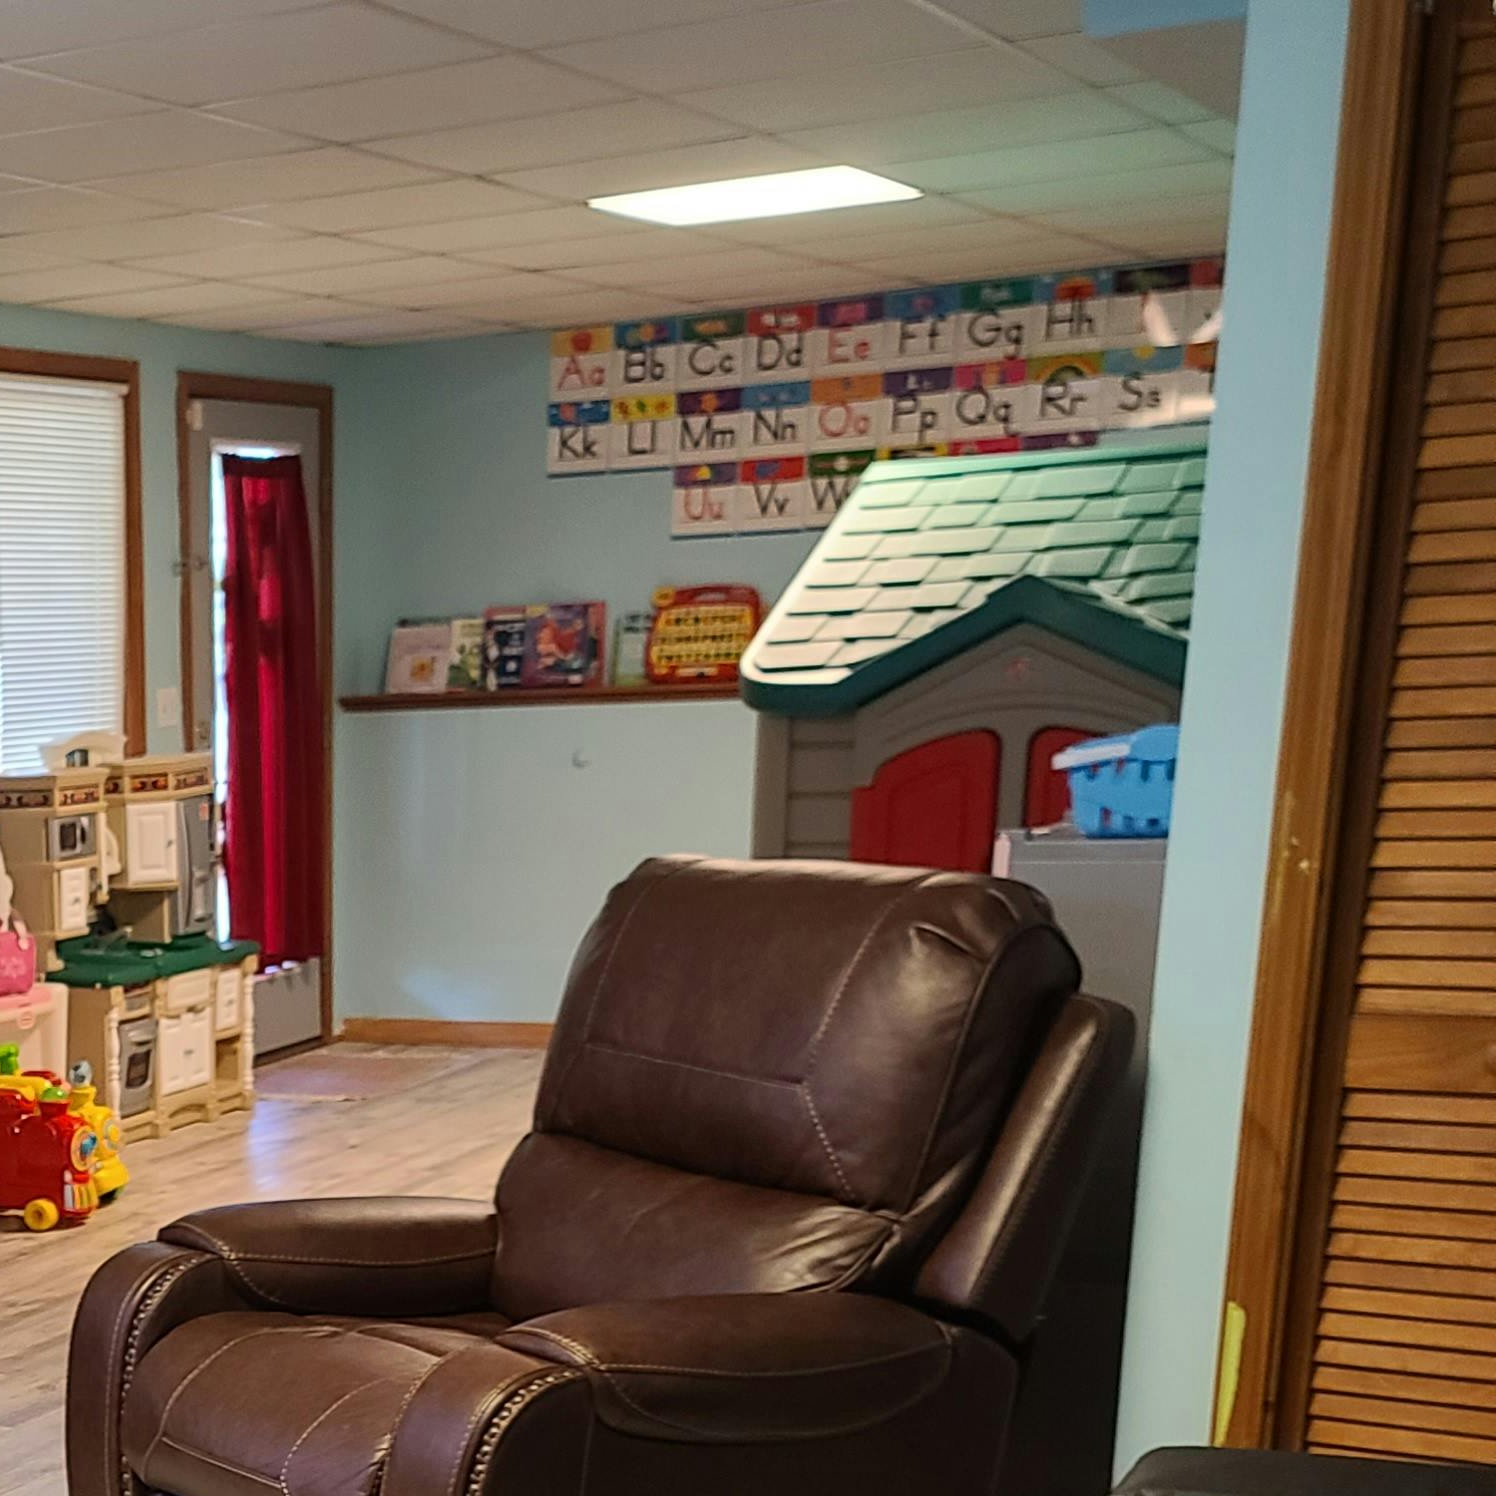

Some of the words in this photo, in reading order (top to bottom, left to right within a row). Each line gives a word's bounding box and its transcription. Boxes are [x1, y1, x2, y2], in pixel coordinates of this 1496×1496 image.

[557, 354, 606, 390] Aa
[623, 347, 665, 384] Bb
[688, 341, 735, 376] Cc
[756, 333, 803, 371] Dd
[827, 327, 871, 363] Ee
[898, 314, 946, 355] Ff
[967, 309, 1022, 361] Gg
[1044, 298, 1094, 341] Hh
[558, 426, 598, 460] Kk
[679, 415, 736, 451] Mm
[754, 410, 797, 445] Nn
[818, 402, 871, 438] Oo
[891, 396, 938, 445] Pp
[955, 389, 1016, 438] Qq
[1039, 375, 1088, 419] Rr
[1117, 371, 1162, 412] Ss
[683, 486, 724, 521] Uu
[753, 482, 790, 517] Vv
